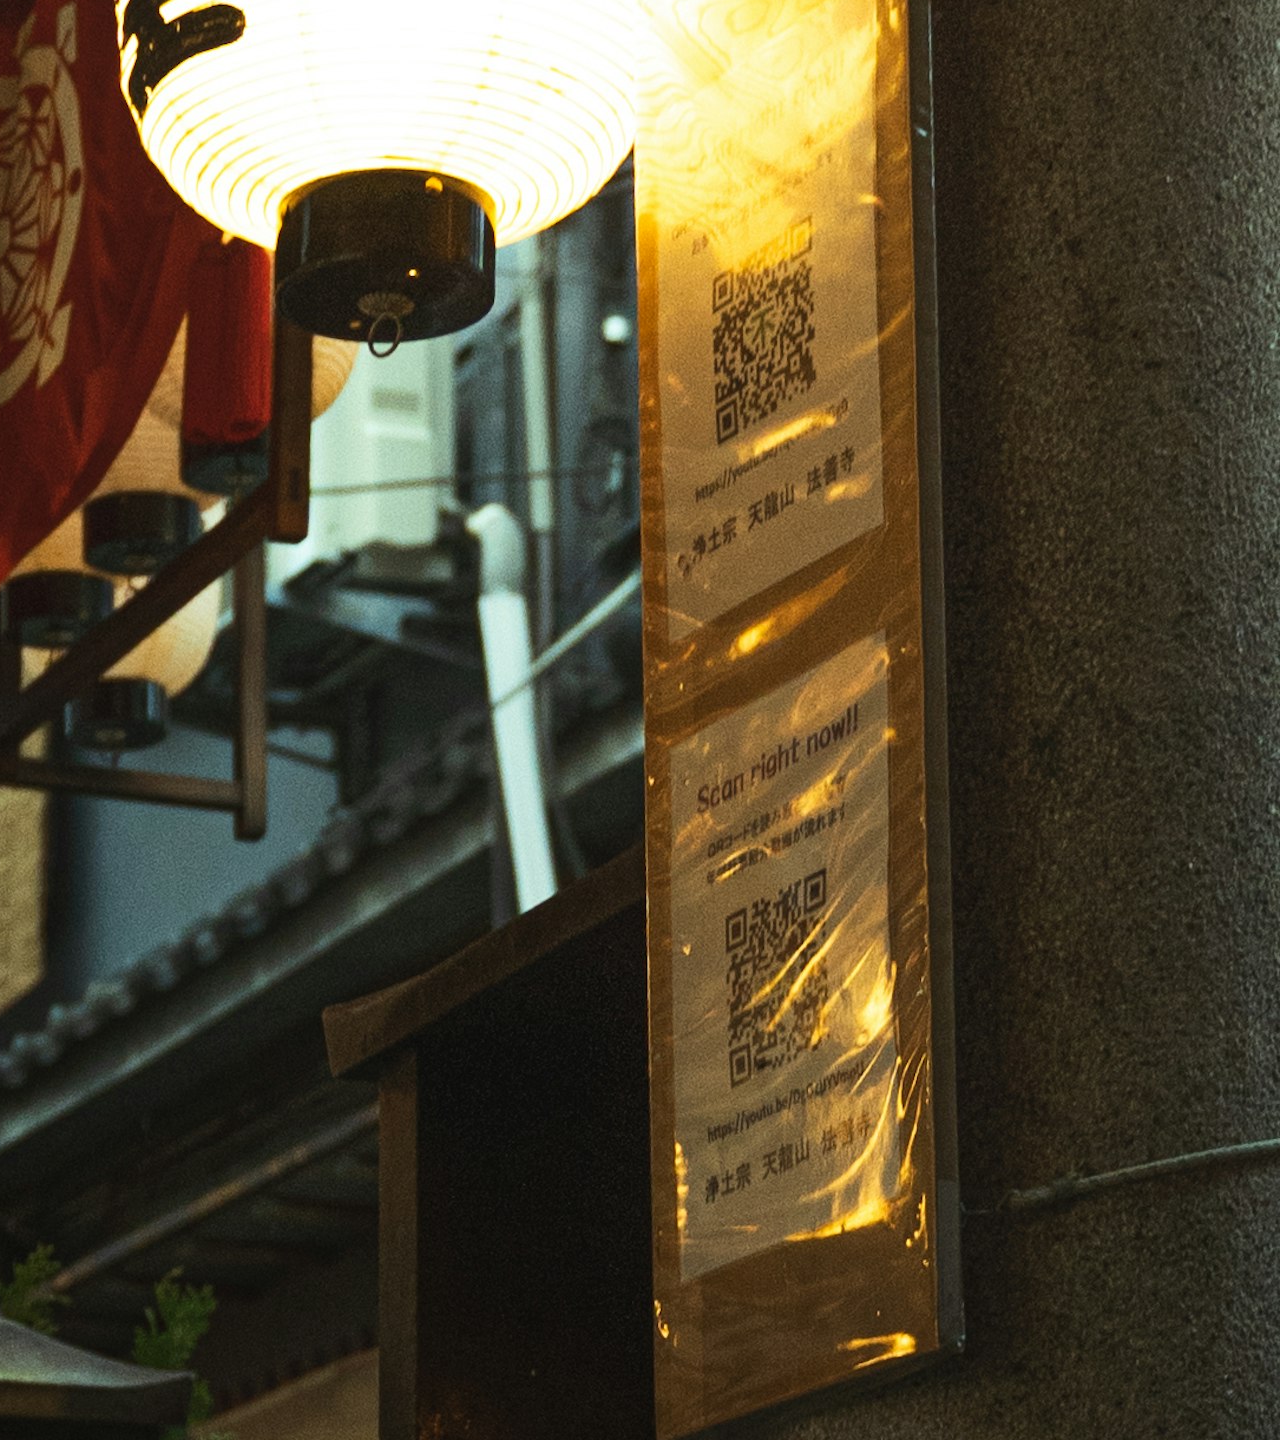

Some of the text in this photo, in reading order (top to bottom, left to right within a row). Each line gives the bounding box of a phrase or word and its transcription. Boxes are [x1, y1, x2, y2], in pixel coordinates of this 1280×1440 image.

[692, 446, 855, 563] 浄土宗 天龍山 法善寺
[697, 703, 859, 815] Scan right now!!
[705, 1162, 751, 1204] 浄土宗
[762, 1136, 811, 1181] 天龍山
